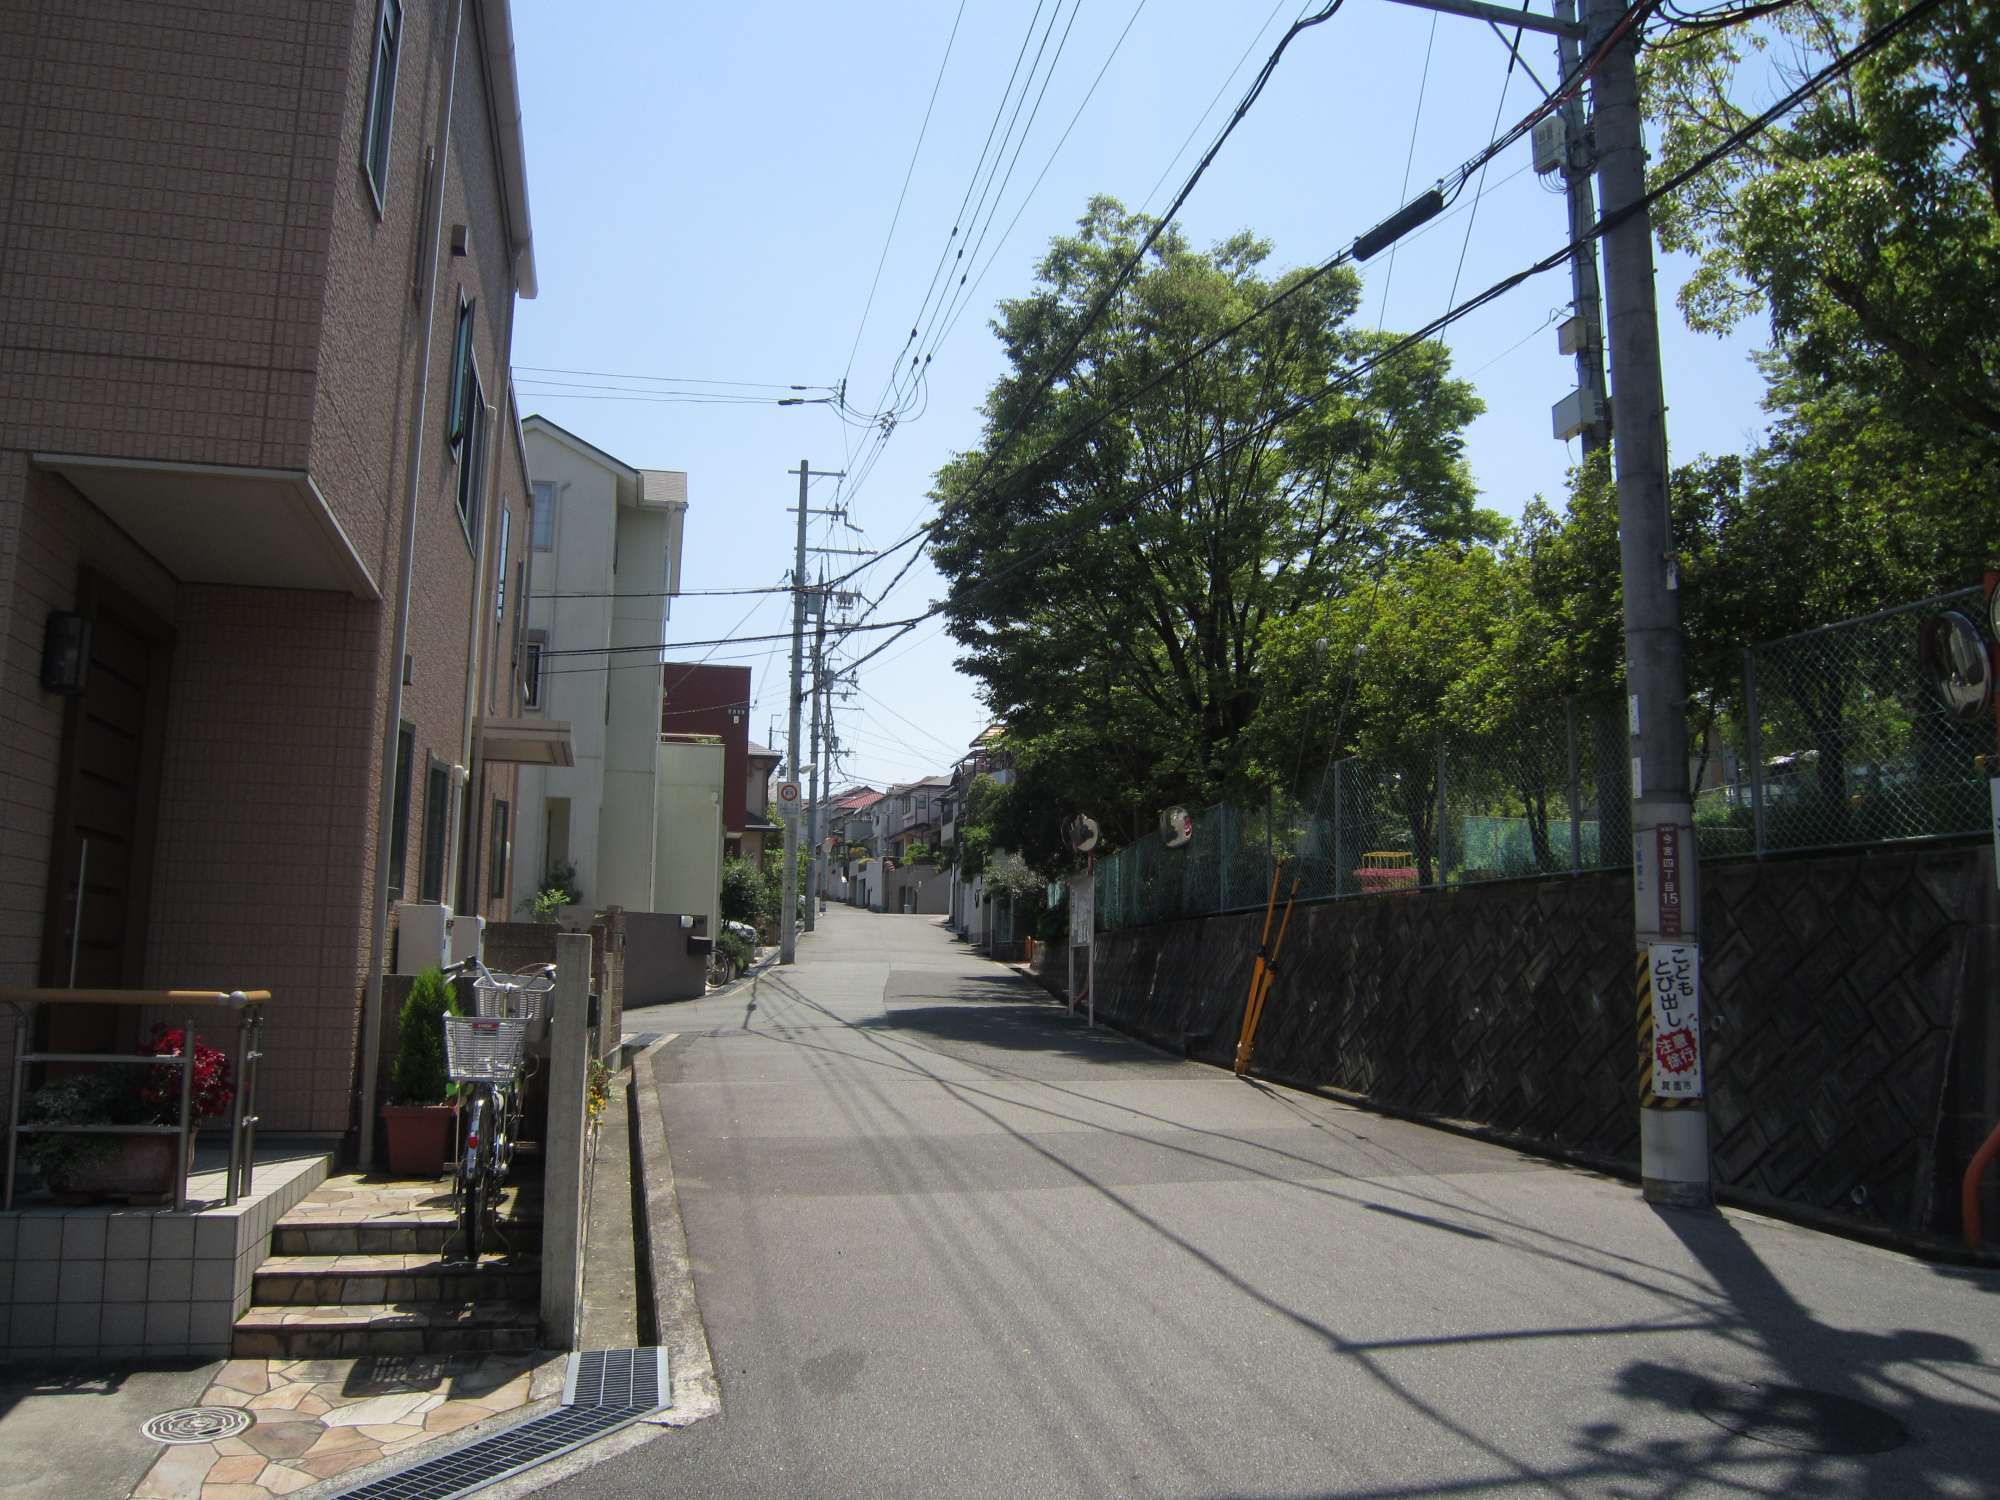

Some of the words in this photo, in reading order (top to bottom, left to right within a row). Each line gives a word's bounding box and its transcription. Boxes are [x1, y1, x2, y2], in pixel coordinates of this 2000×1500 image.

[1663, 892, 1679, 905] 15
[1655, 960, 1681, 1027] とび出し
[1672, 948, 1694, 996] こども
